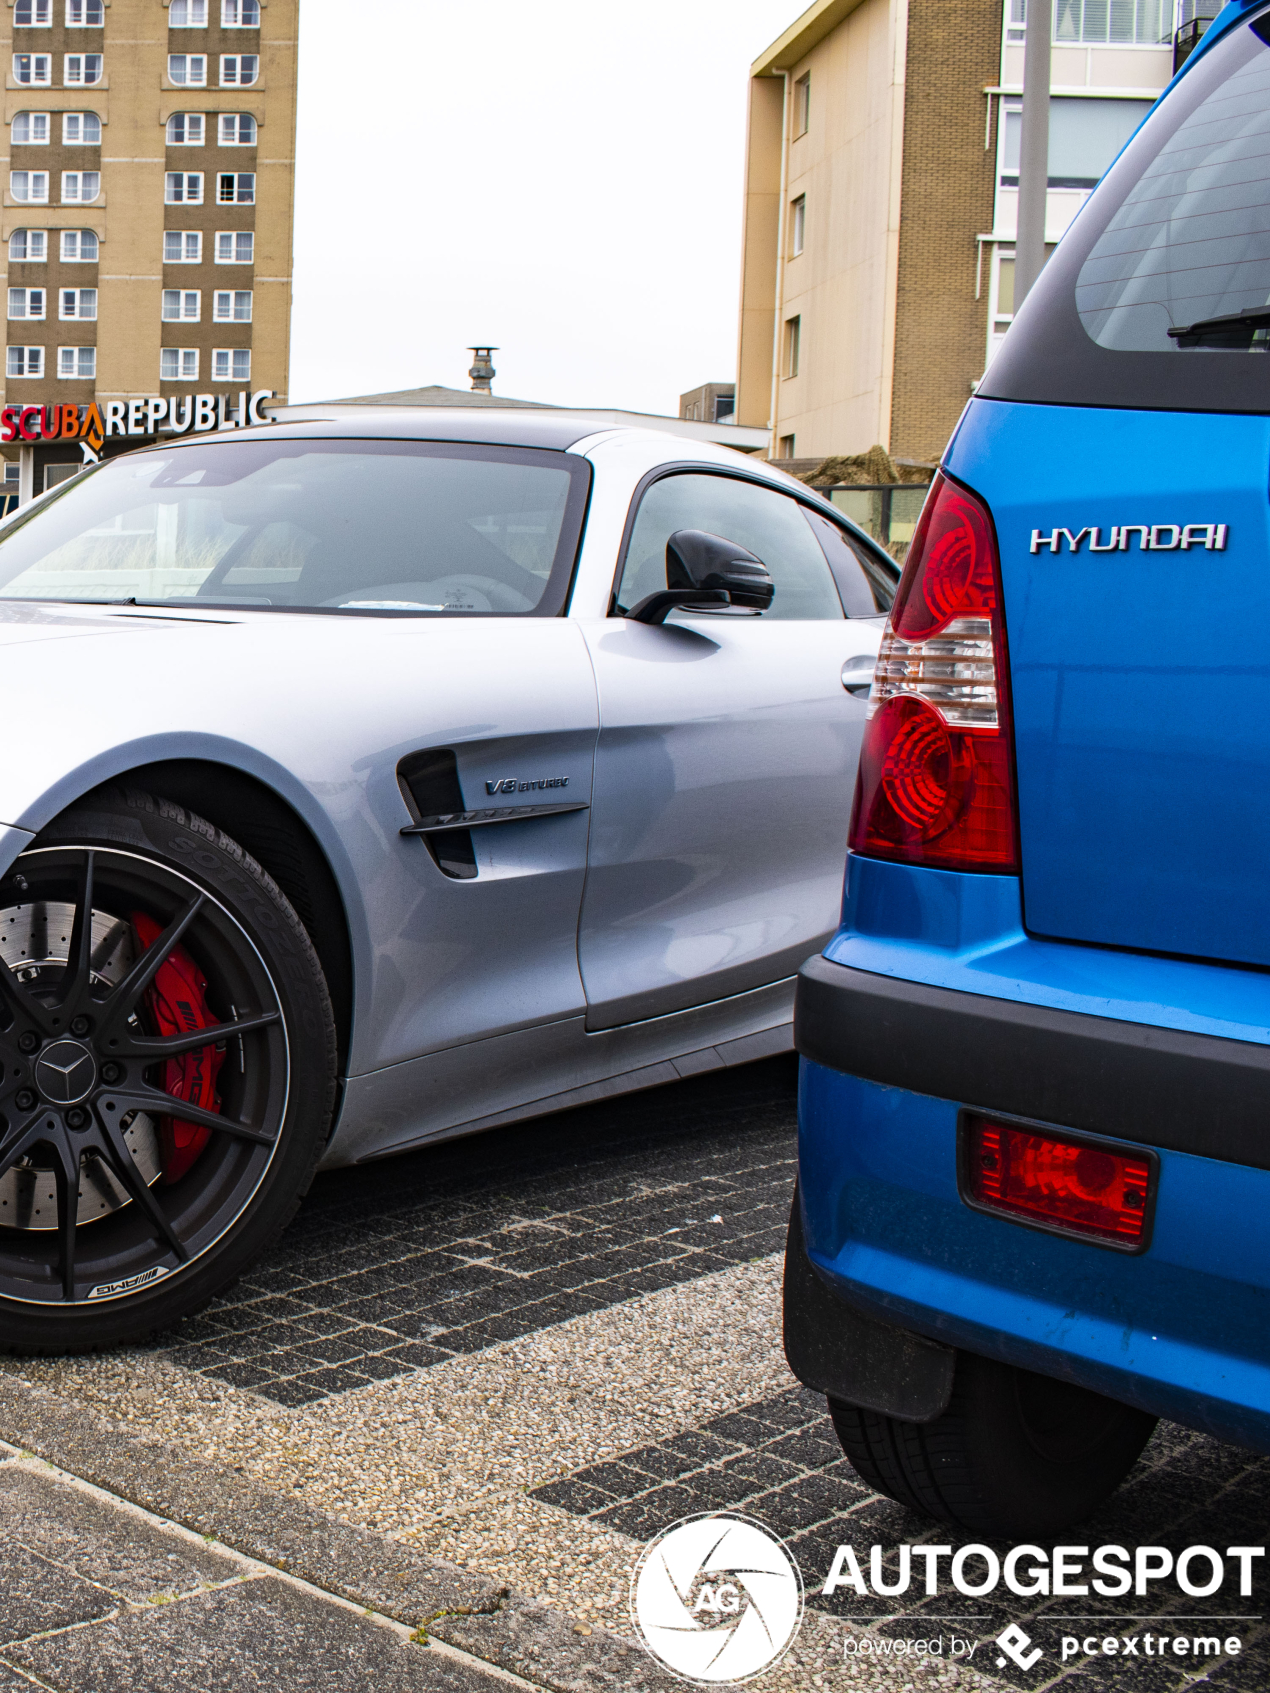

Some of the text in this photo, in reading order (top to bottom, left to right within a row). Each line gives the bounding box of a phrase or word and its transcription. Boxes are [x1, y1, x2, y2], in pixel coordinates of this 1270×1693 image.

[1, 389, 277, 442] SCUBA REPUBLIC
[1029, 523, 1228, 554] HYUNDAI
[485, 776, 570, 795] V8 BITURBO
[97, 1276, 139, 1296] AMG
